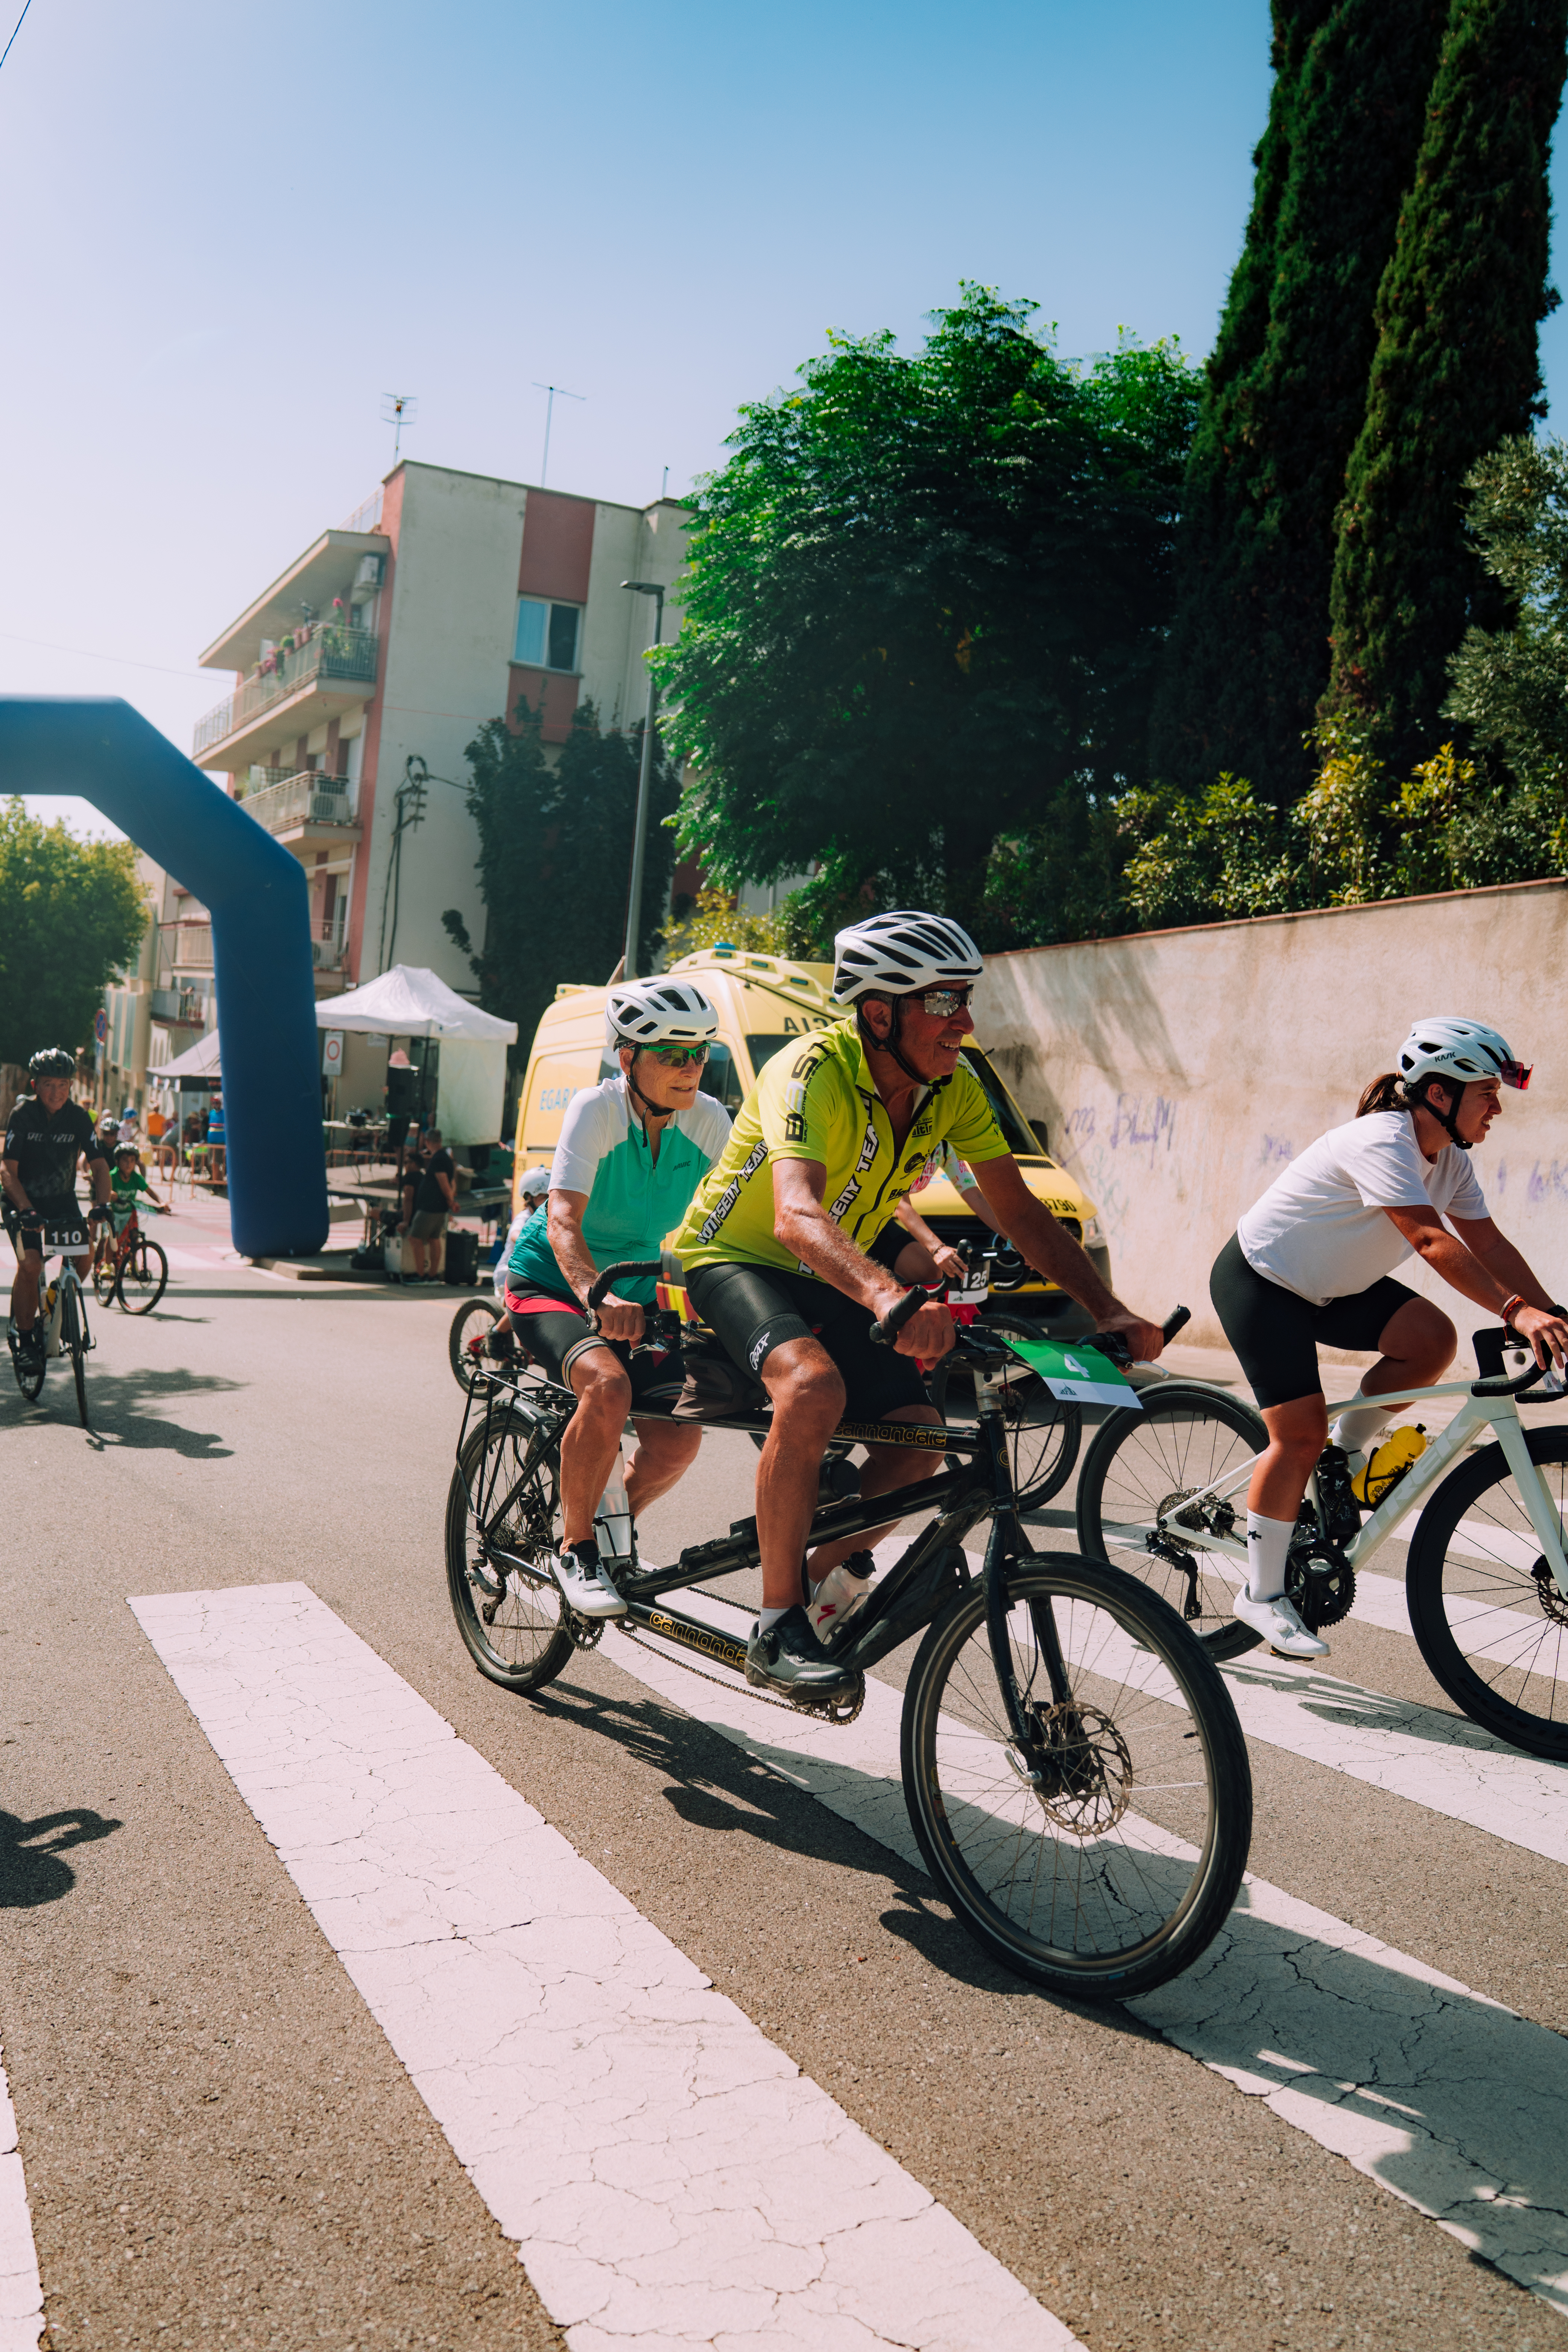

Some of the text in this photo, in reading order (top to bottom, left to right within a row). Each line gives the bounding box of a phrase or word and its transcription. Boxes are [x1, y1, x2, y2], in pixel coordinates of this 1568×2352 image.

[1435, 1052, 1456, 1062] KASK
[673, 1161, 691, 1171] MAVIC
[52, 1231, 82, 1244] 110
[962, 1270, 988, 1288] 125
[1064, 1354, 1091, 1378] 4
[834, 1422, 947, 1447] cannondale
[1358, 1411, 1471, 1541] TREK
[650, 1610, 748, 1670] cannonda
